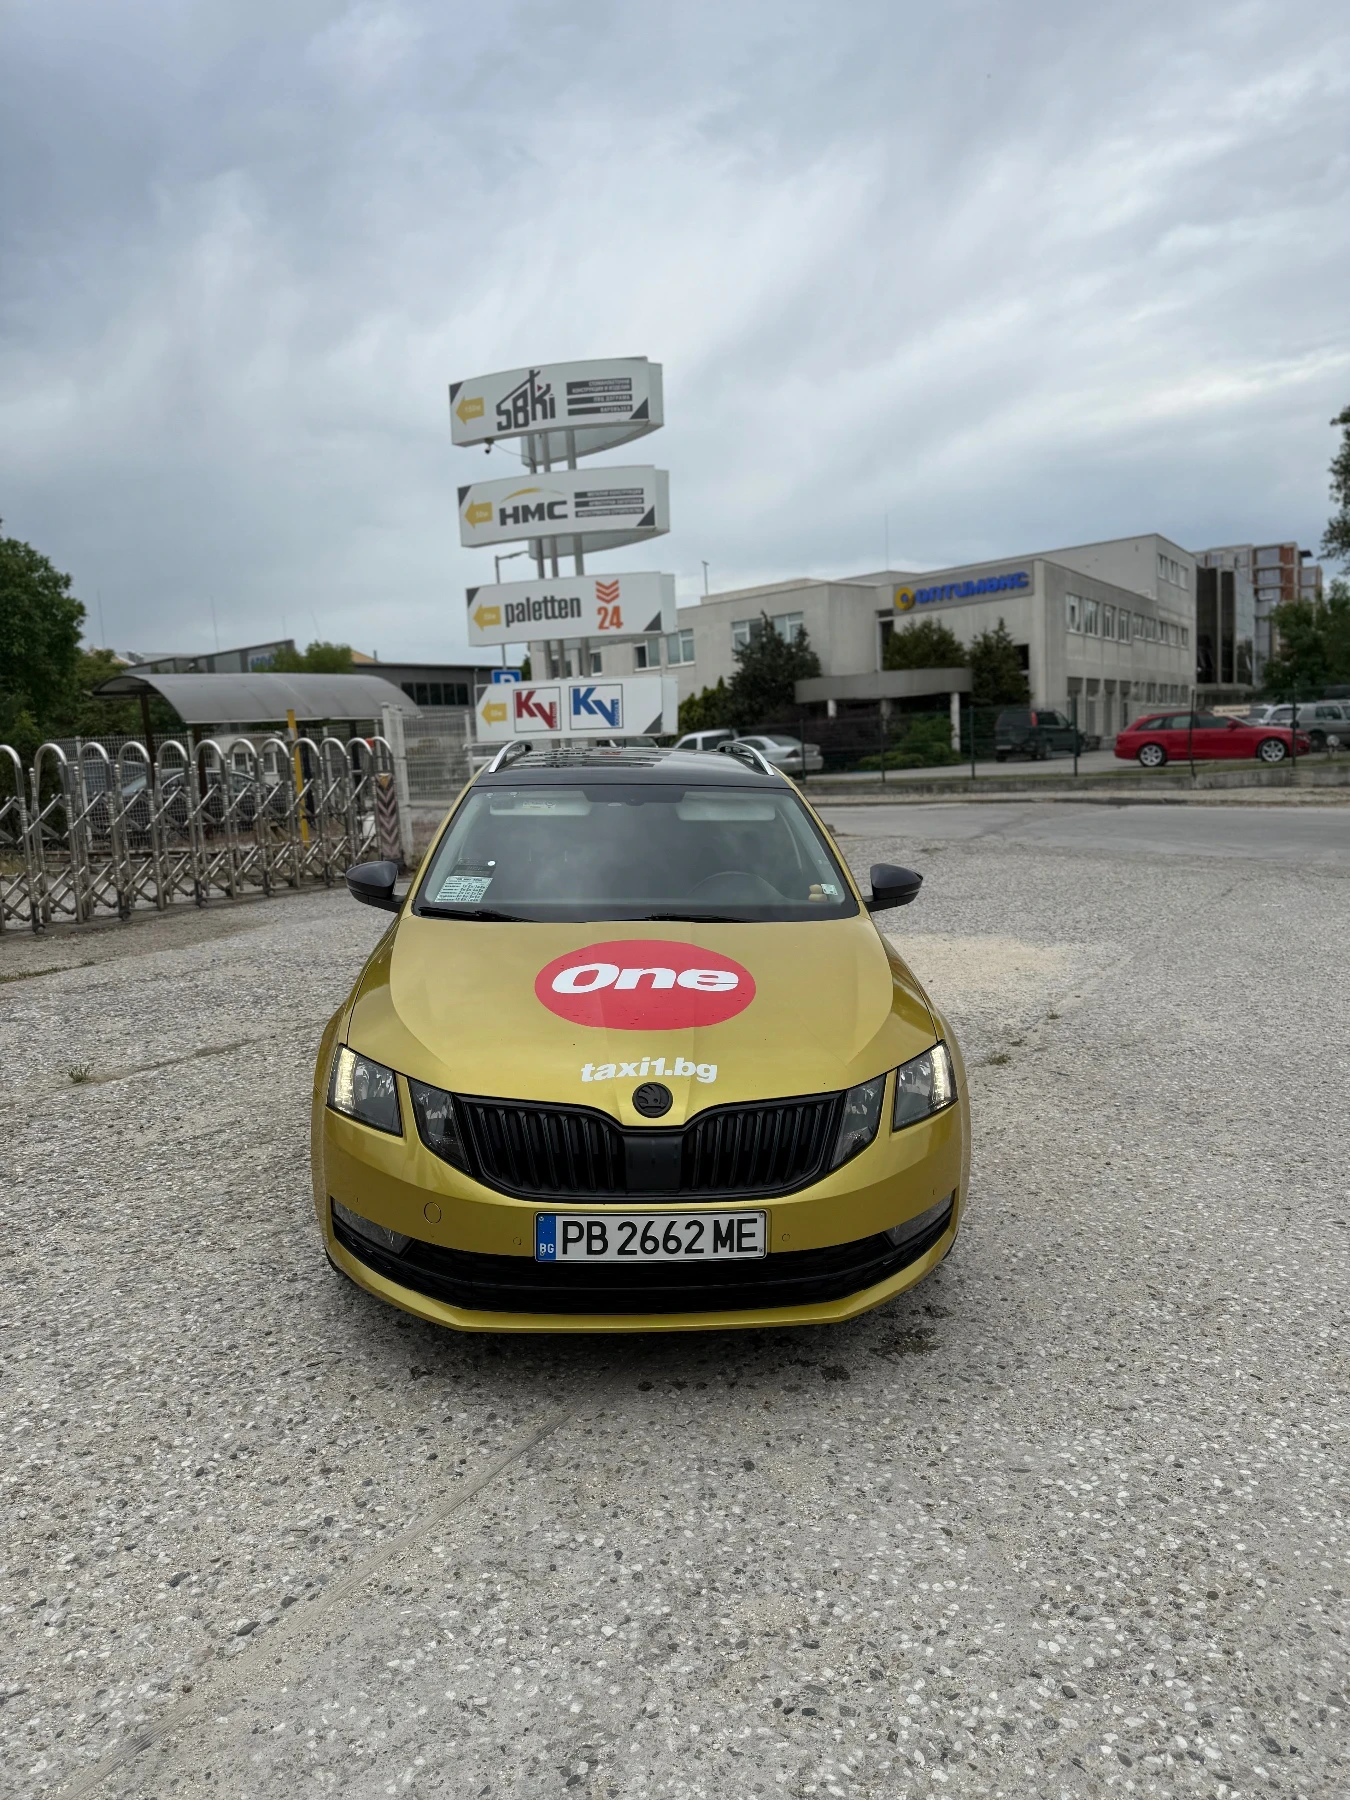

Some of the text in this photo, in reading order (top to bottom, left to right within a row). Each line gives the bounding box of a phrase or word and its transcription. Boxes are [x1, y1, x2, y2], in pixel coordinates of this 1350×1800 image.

[499, 501, 568, 526] HMC
[504, 595, 582, 628] paletten
[597, 605, 624, 630] 24
[551, 962, 739, 994] One
[581, 1056, 718, 1084] taxi1.bg
[539, 1243, 555, 1254] BG
